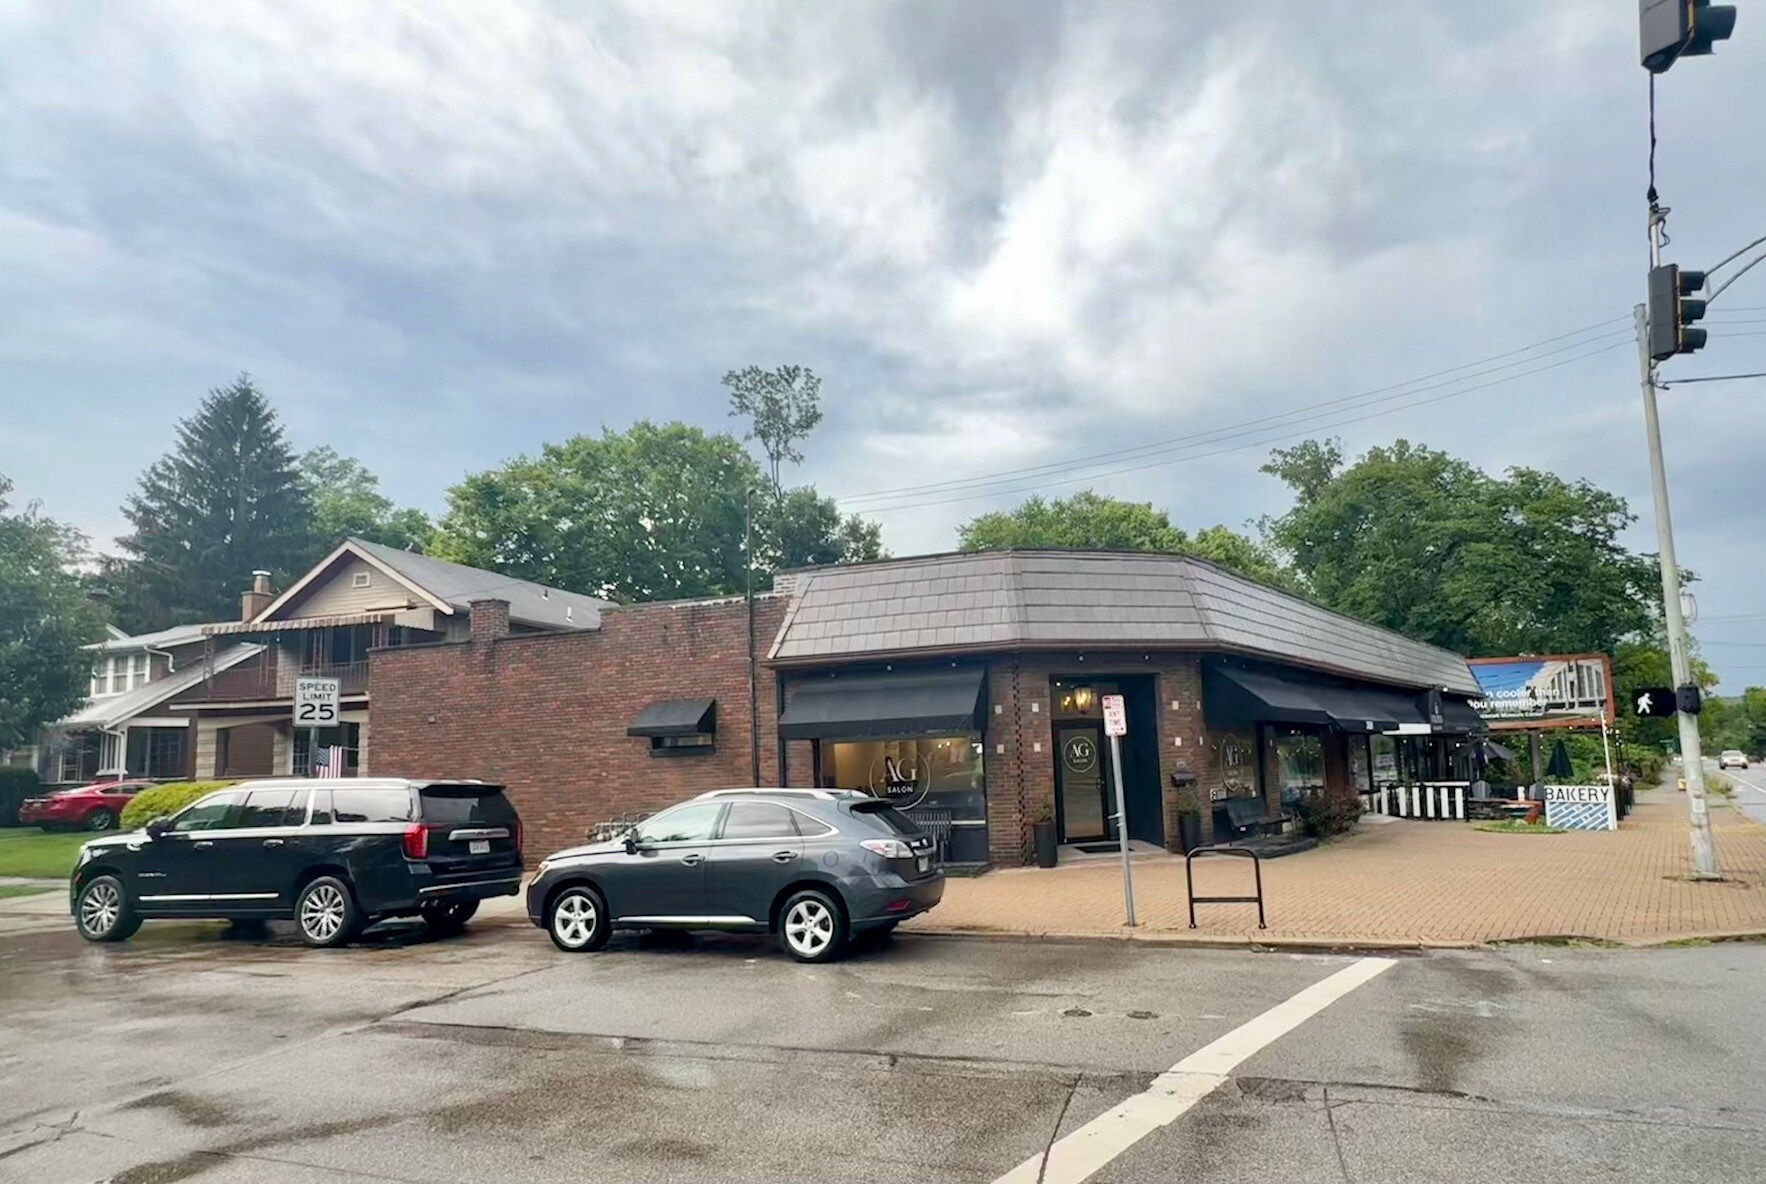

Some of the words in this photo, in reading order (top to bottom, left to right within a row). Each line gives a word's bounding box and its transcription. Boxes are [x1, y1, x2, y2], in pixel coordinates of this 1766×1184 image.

[299, 682, 336, 691] SPEED
[1496, 686, 1533, 698] cooler
[303, 692, 332, 701] LIMIT
[1490, 698, 1547, 709] remember
[300, 703, 334, 720] 25
[880, 757, 917, 782] AG
[886, 785, 914, 794] SALON
[1545, 787, 1609, 802] BAKERY
